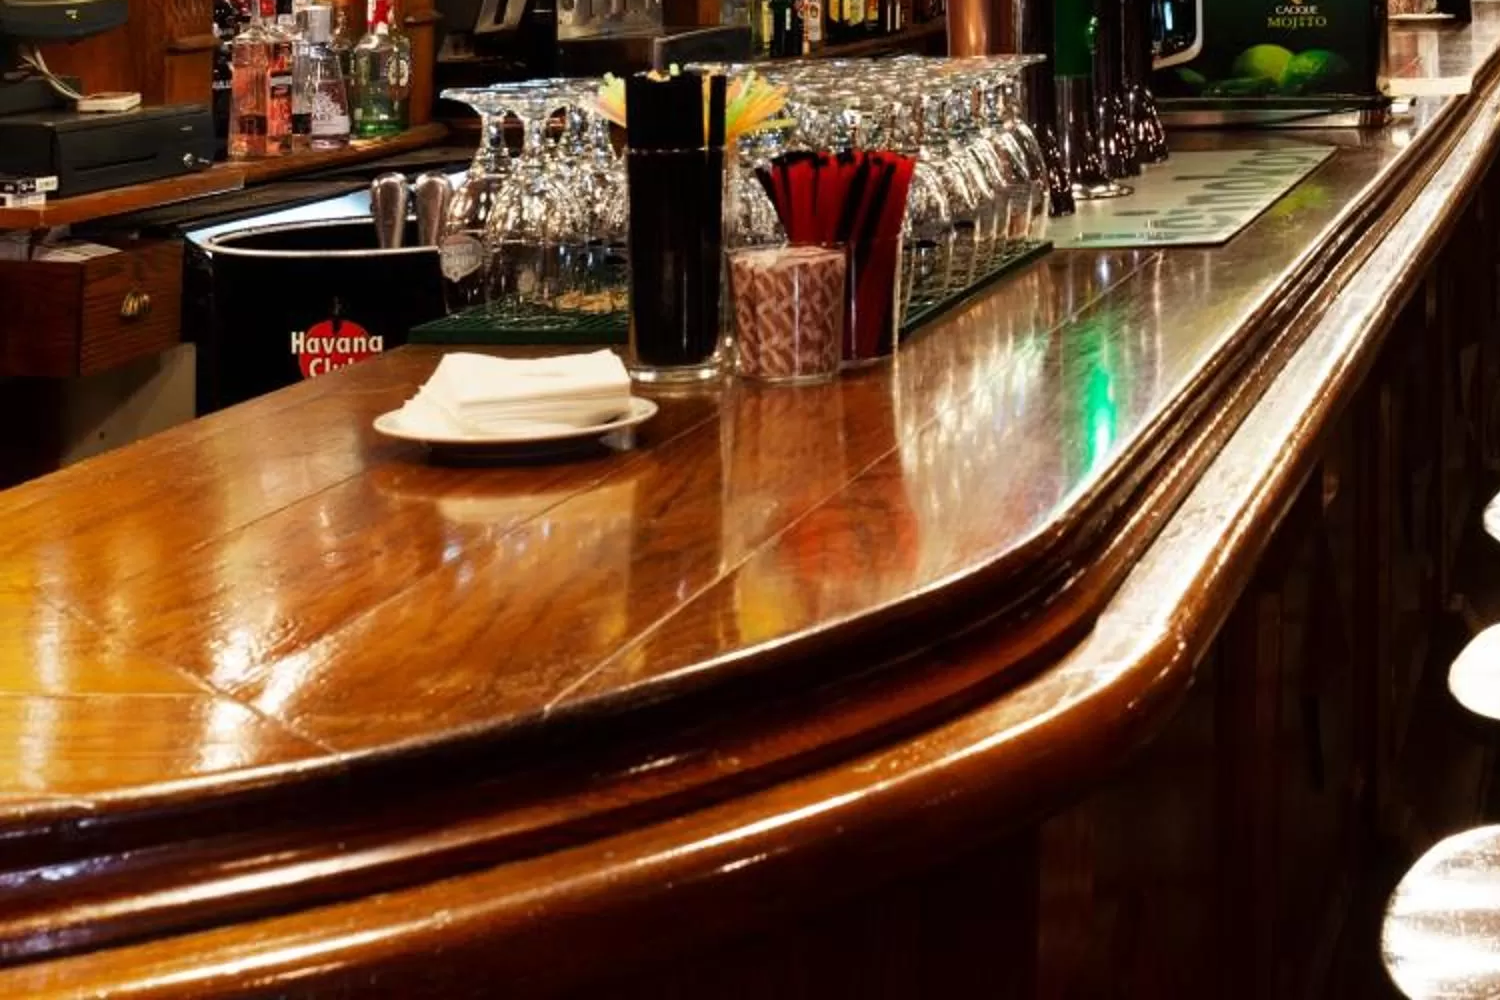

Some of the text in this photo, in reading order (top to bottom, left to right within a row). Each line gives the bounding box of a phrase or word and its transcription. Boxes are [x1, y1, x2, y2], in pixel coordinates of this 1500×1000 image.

[1267, 16, 1328, 30] MOJITO
[291, 331, 383, 354] Havana
[309, 358, 352, 377] Cl
